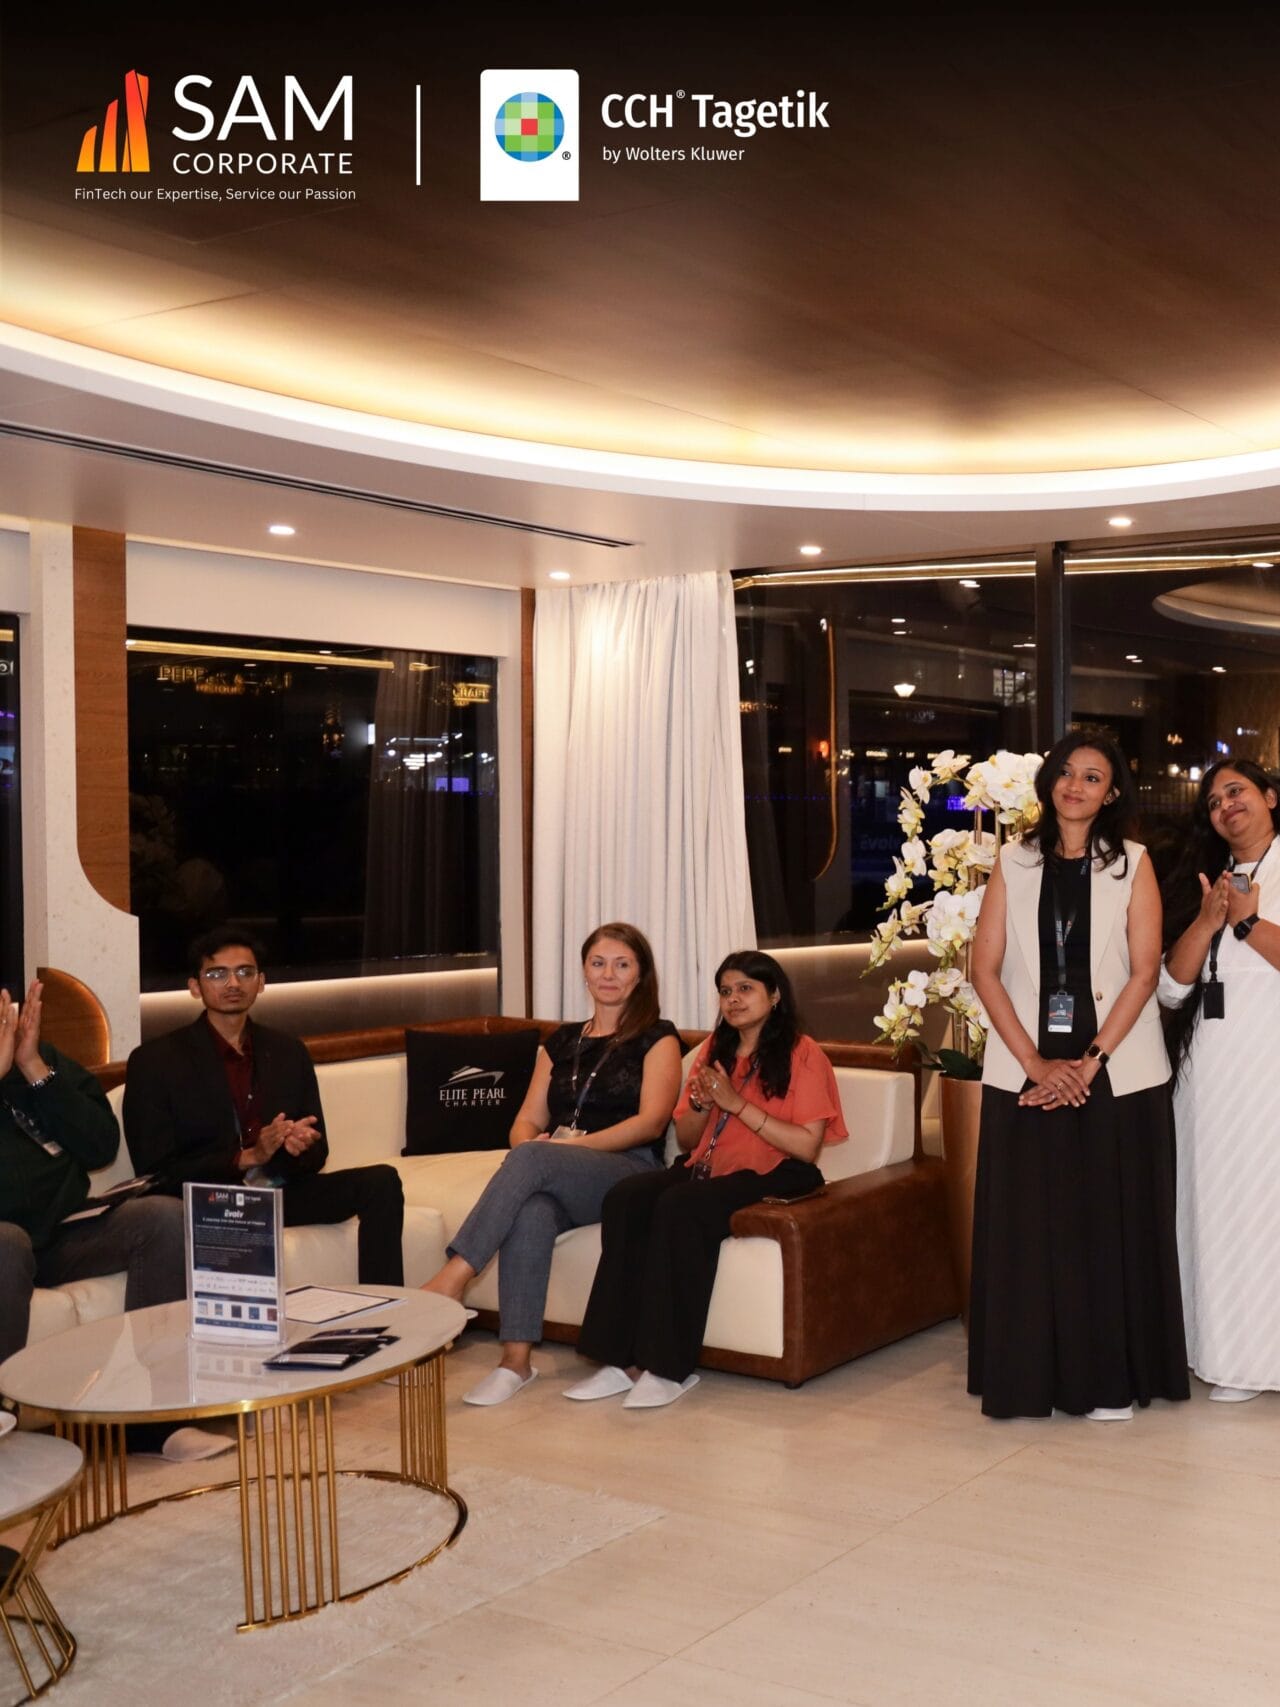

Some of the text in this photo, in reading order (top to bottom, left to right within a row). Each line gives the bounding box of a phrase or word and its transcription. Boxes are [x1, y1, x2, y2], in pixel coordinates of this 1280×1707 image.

[440, 1087, 507, 1101] ELITE PEARL
[445, 1099, 501, 1108] CHARTER
